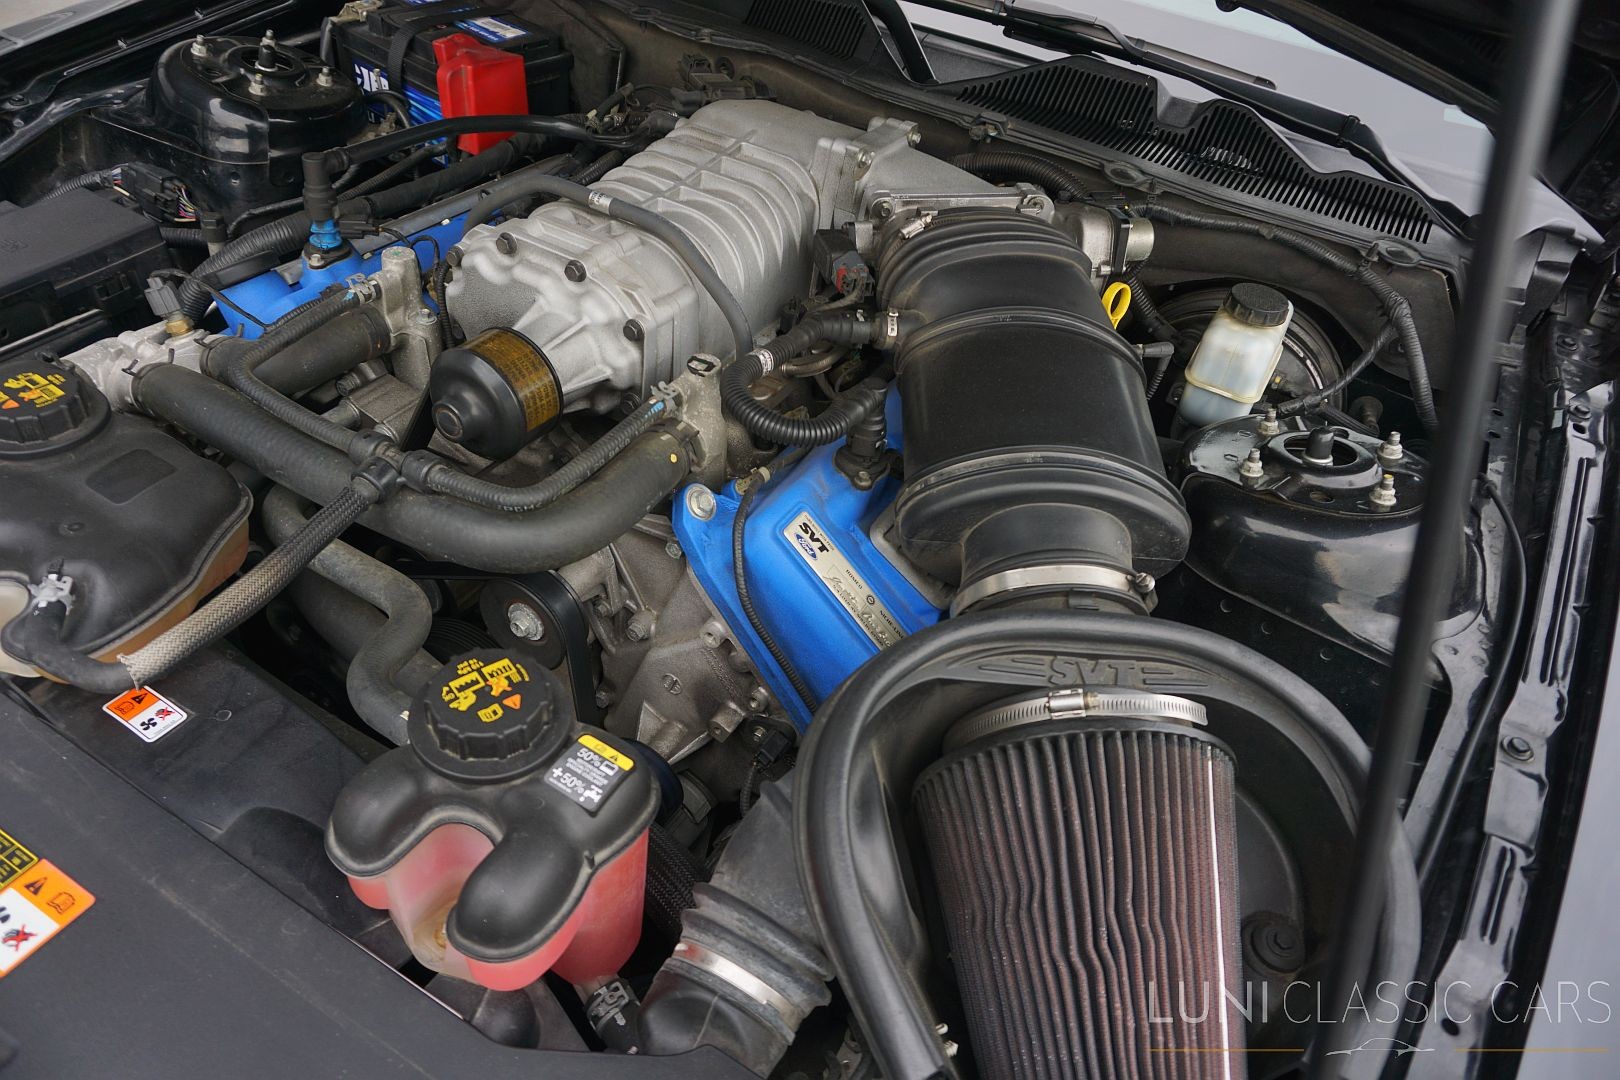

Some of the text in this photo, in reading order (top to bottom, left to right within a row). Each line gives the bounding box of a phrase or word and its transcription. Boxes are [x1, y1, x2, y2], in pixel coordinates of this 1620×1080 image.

[797, 537, 816, 557] Ford
[799, 522, 829, 553] SVT
[1048, 656, 1136, 687] SVT
[576, 747, 602, 767] 50%
